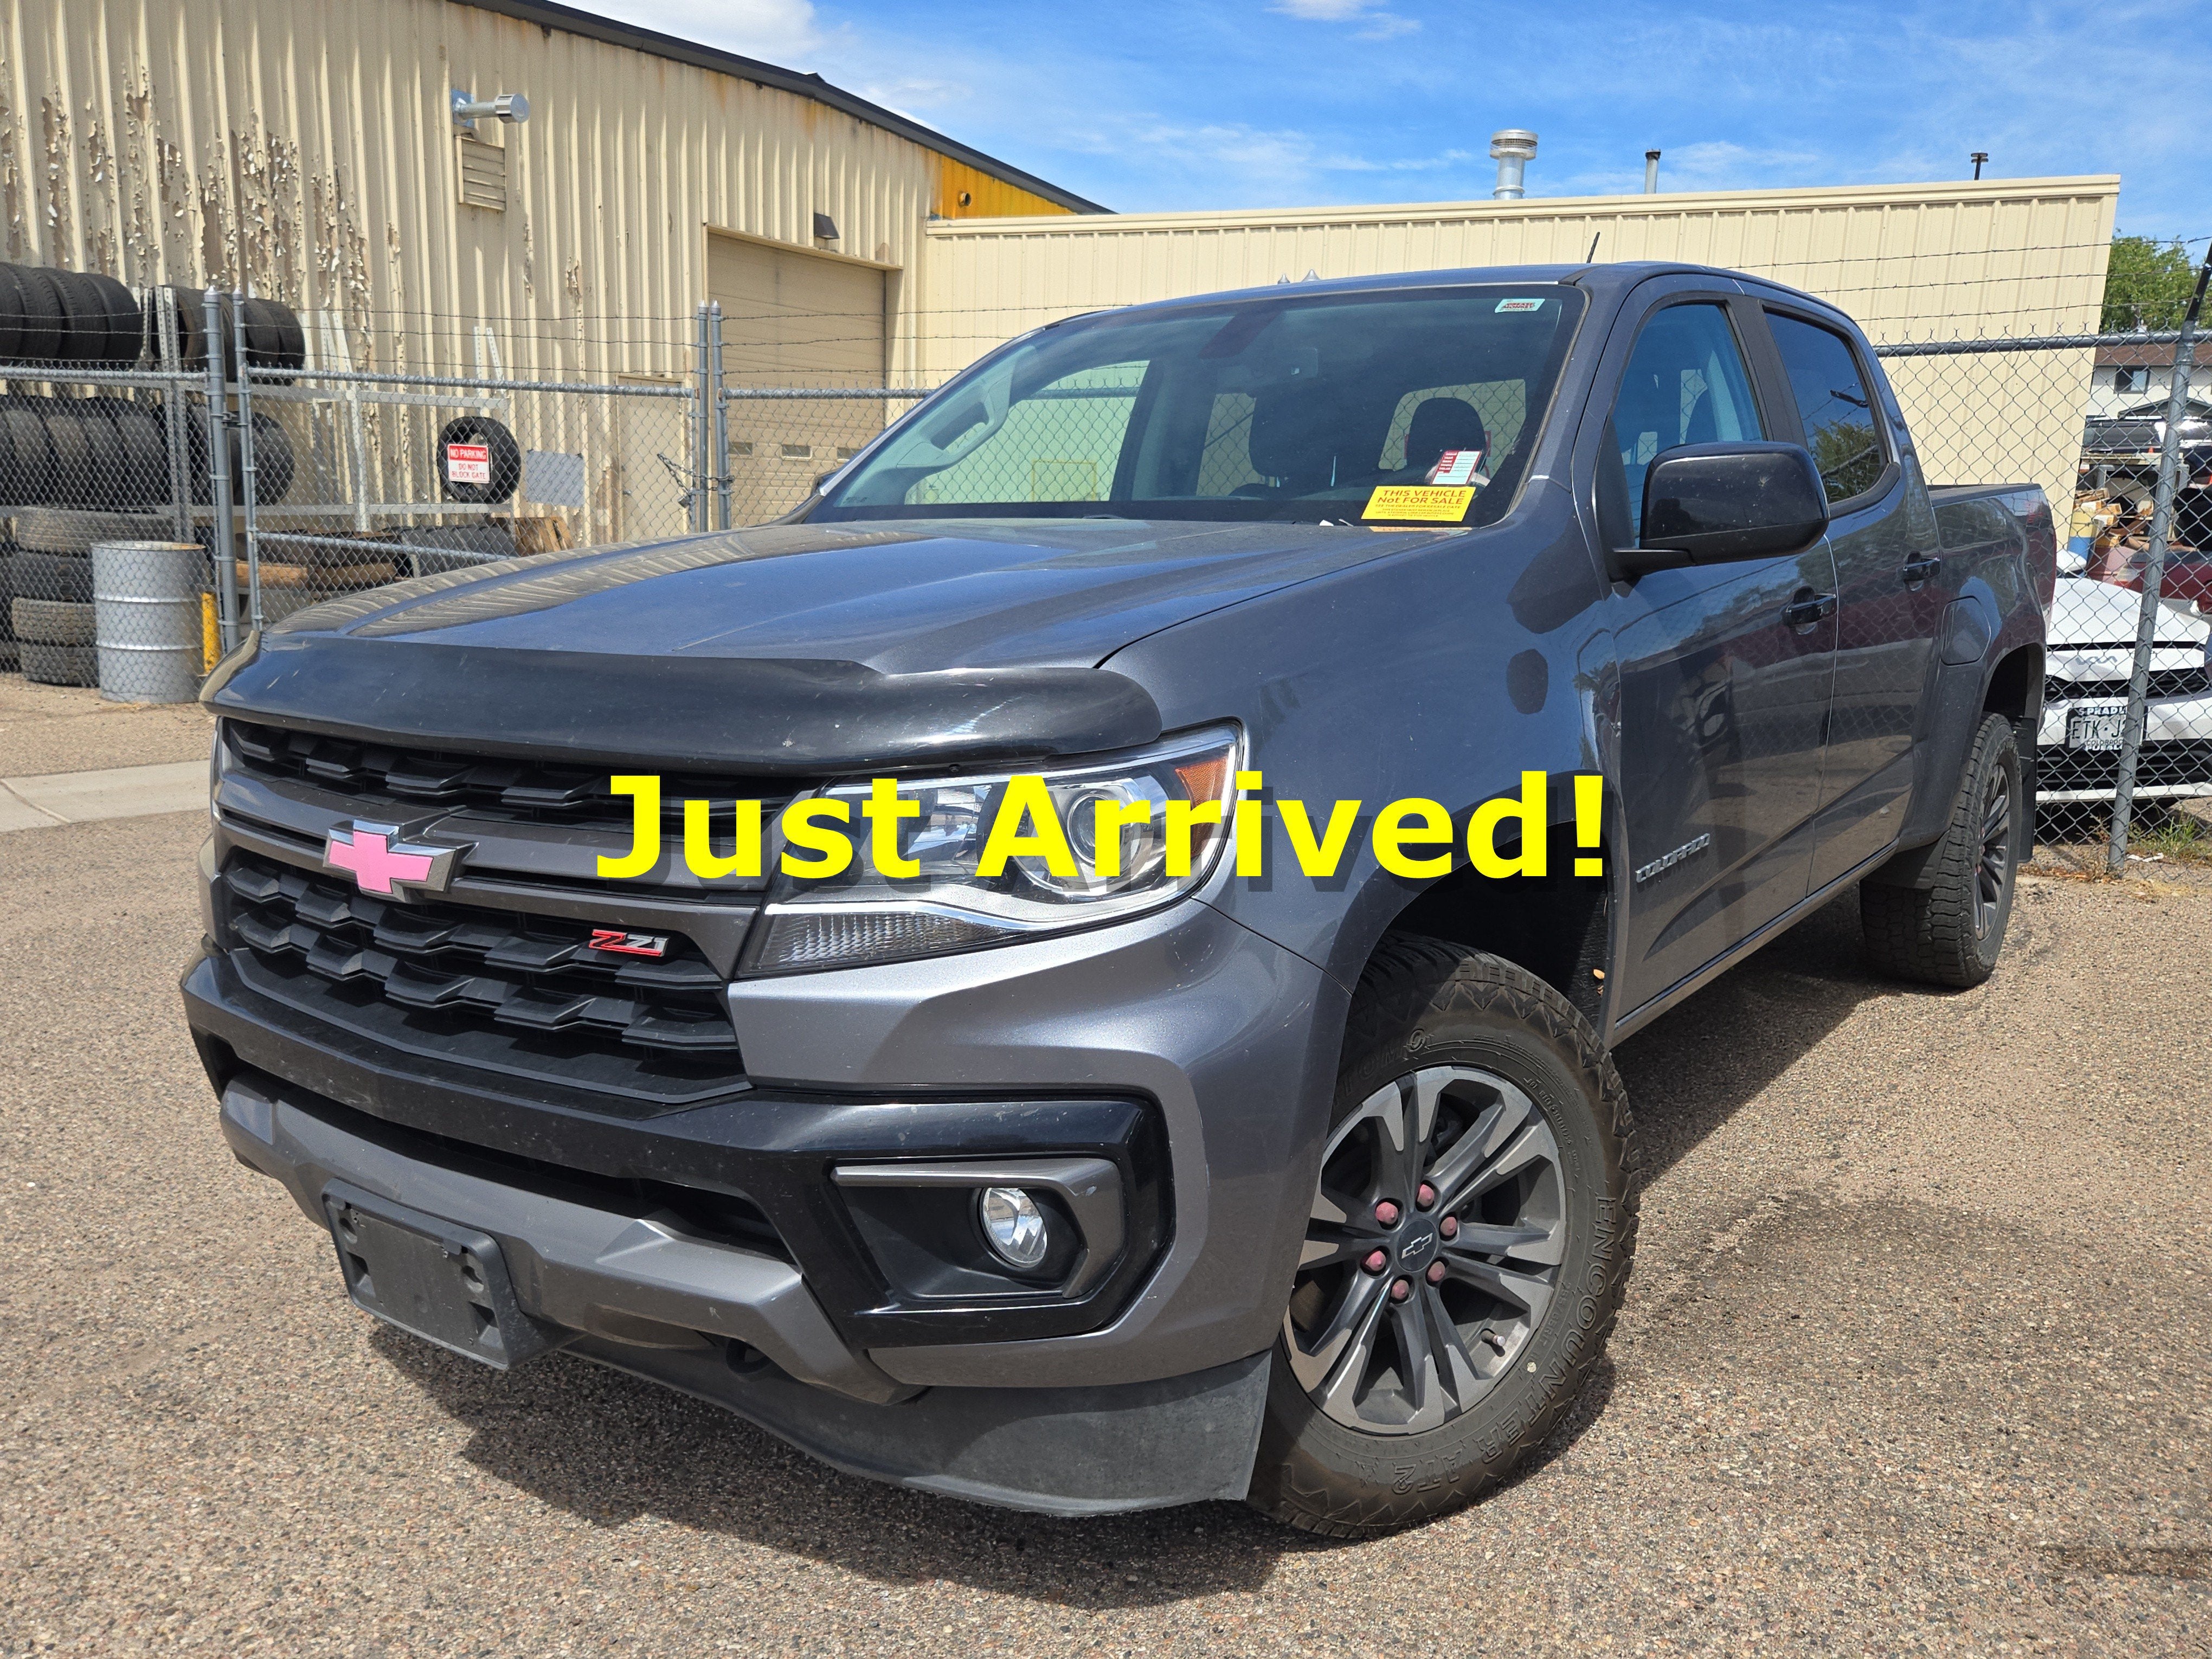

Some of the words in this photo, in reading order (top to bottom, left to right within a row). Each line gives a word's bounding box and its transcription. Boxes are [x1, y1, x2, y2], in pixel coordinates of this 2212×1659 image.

[450, 448, 459, 458] NO
[460, 449, 486, 459] PARKING
[1635, 833, 1711, 883] COLORADO
[1475, 1195, 1616, 1464] ENCOUNTER
